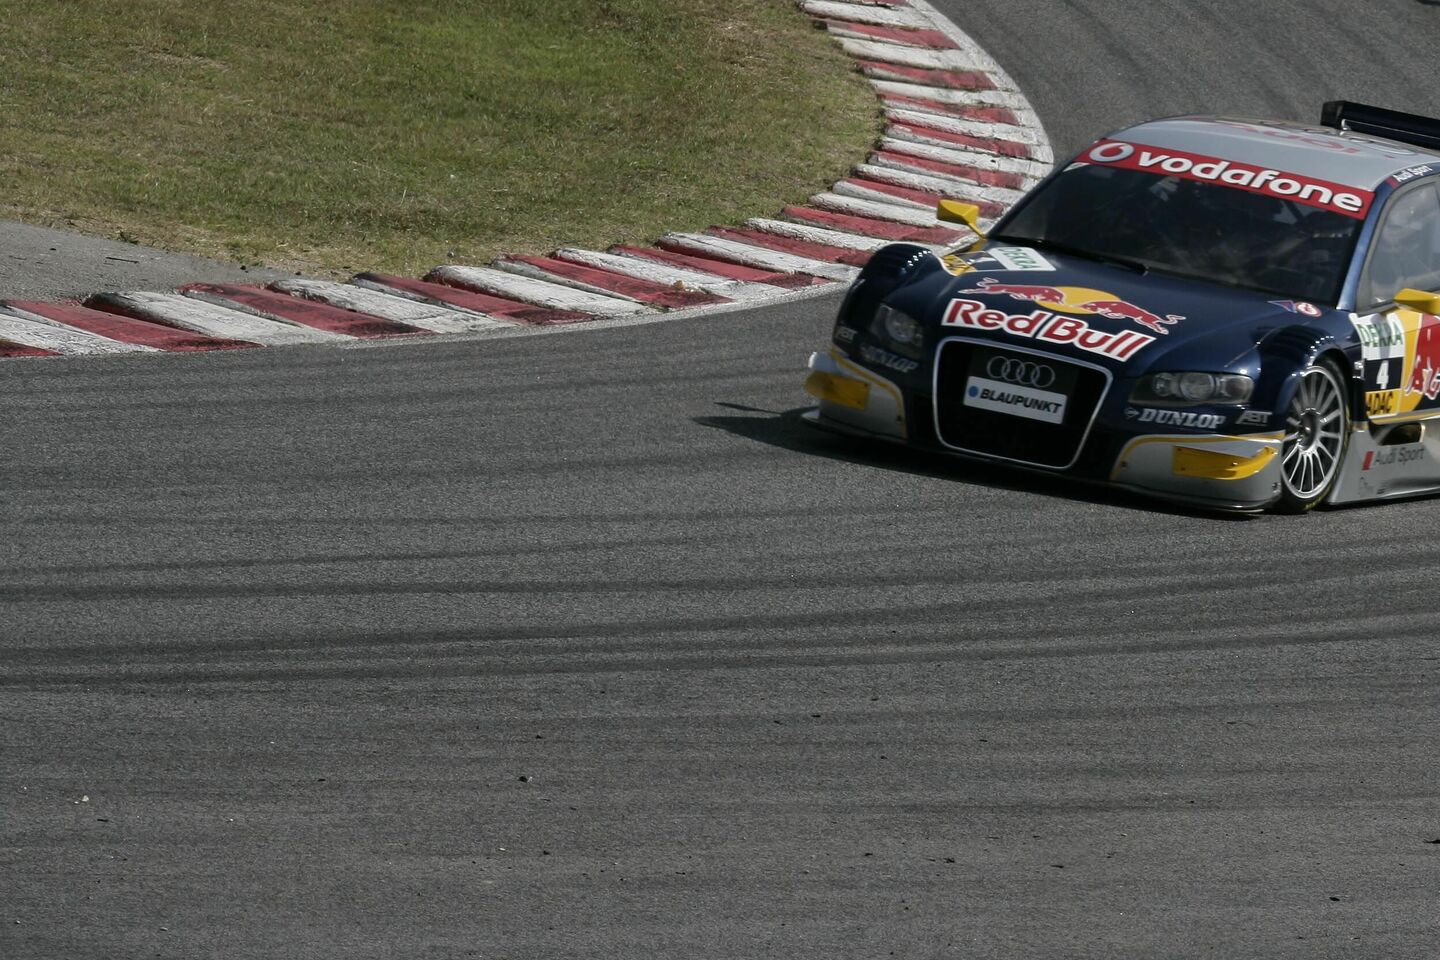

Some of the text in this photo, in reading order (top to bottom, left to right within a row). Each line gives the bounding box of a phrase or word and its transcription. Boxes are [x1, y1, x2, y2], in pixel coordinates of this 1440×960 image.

[1137, 151, 1364, 214] vodafone
[1393, 164, 1433, 183] Audi Sport
[942, 298, 1157, 363] Red Bull
[1355, 320, 1404, 348] DEKRA
[1375, 360, 1390, 390] 4
[979, 388, 1063, 415] BLAUPUNKT
[1366, 391, 1395, 416] ADAC
[1137, 408, 1228, 430] DUNLOP
[1236, 410, 1273, 426] ABT
[1373, 444, 1426, 467] Audi Sport
